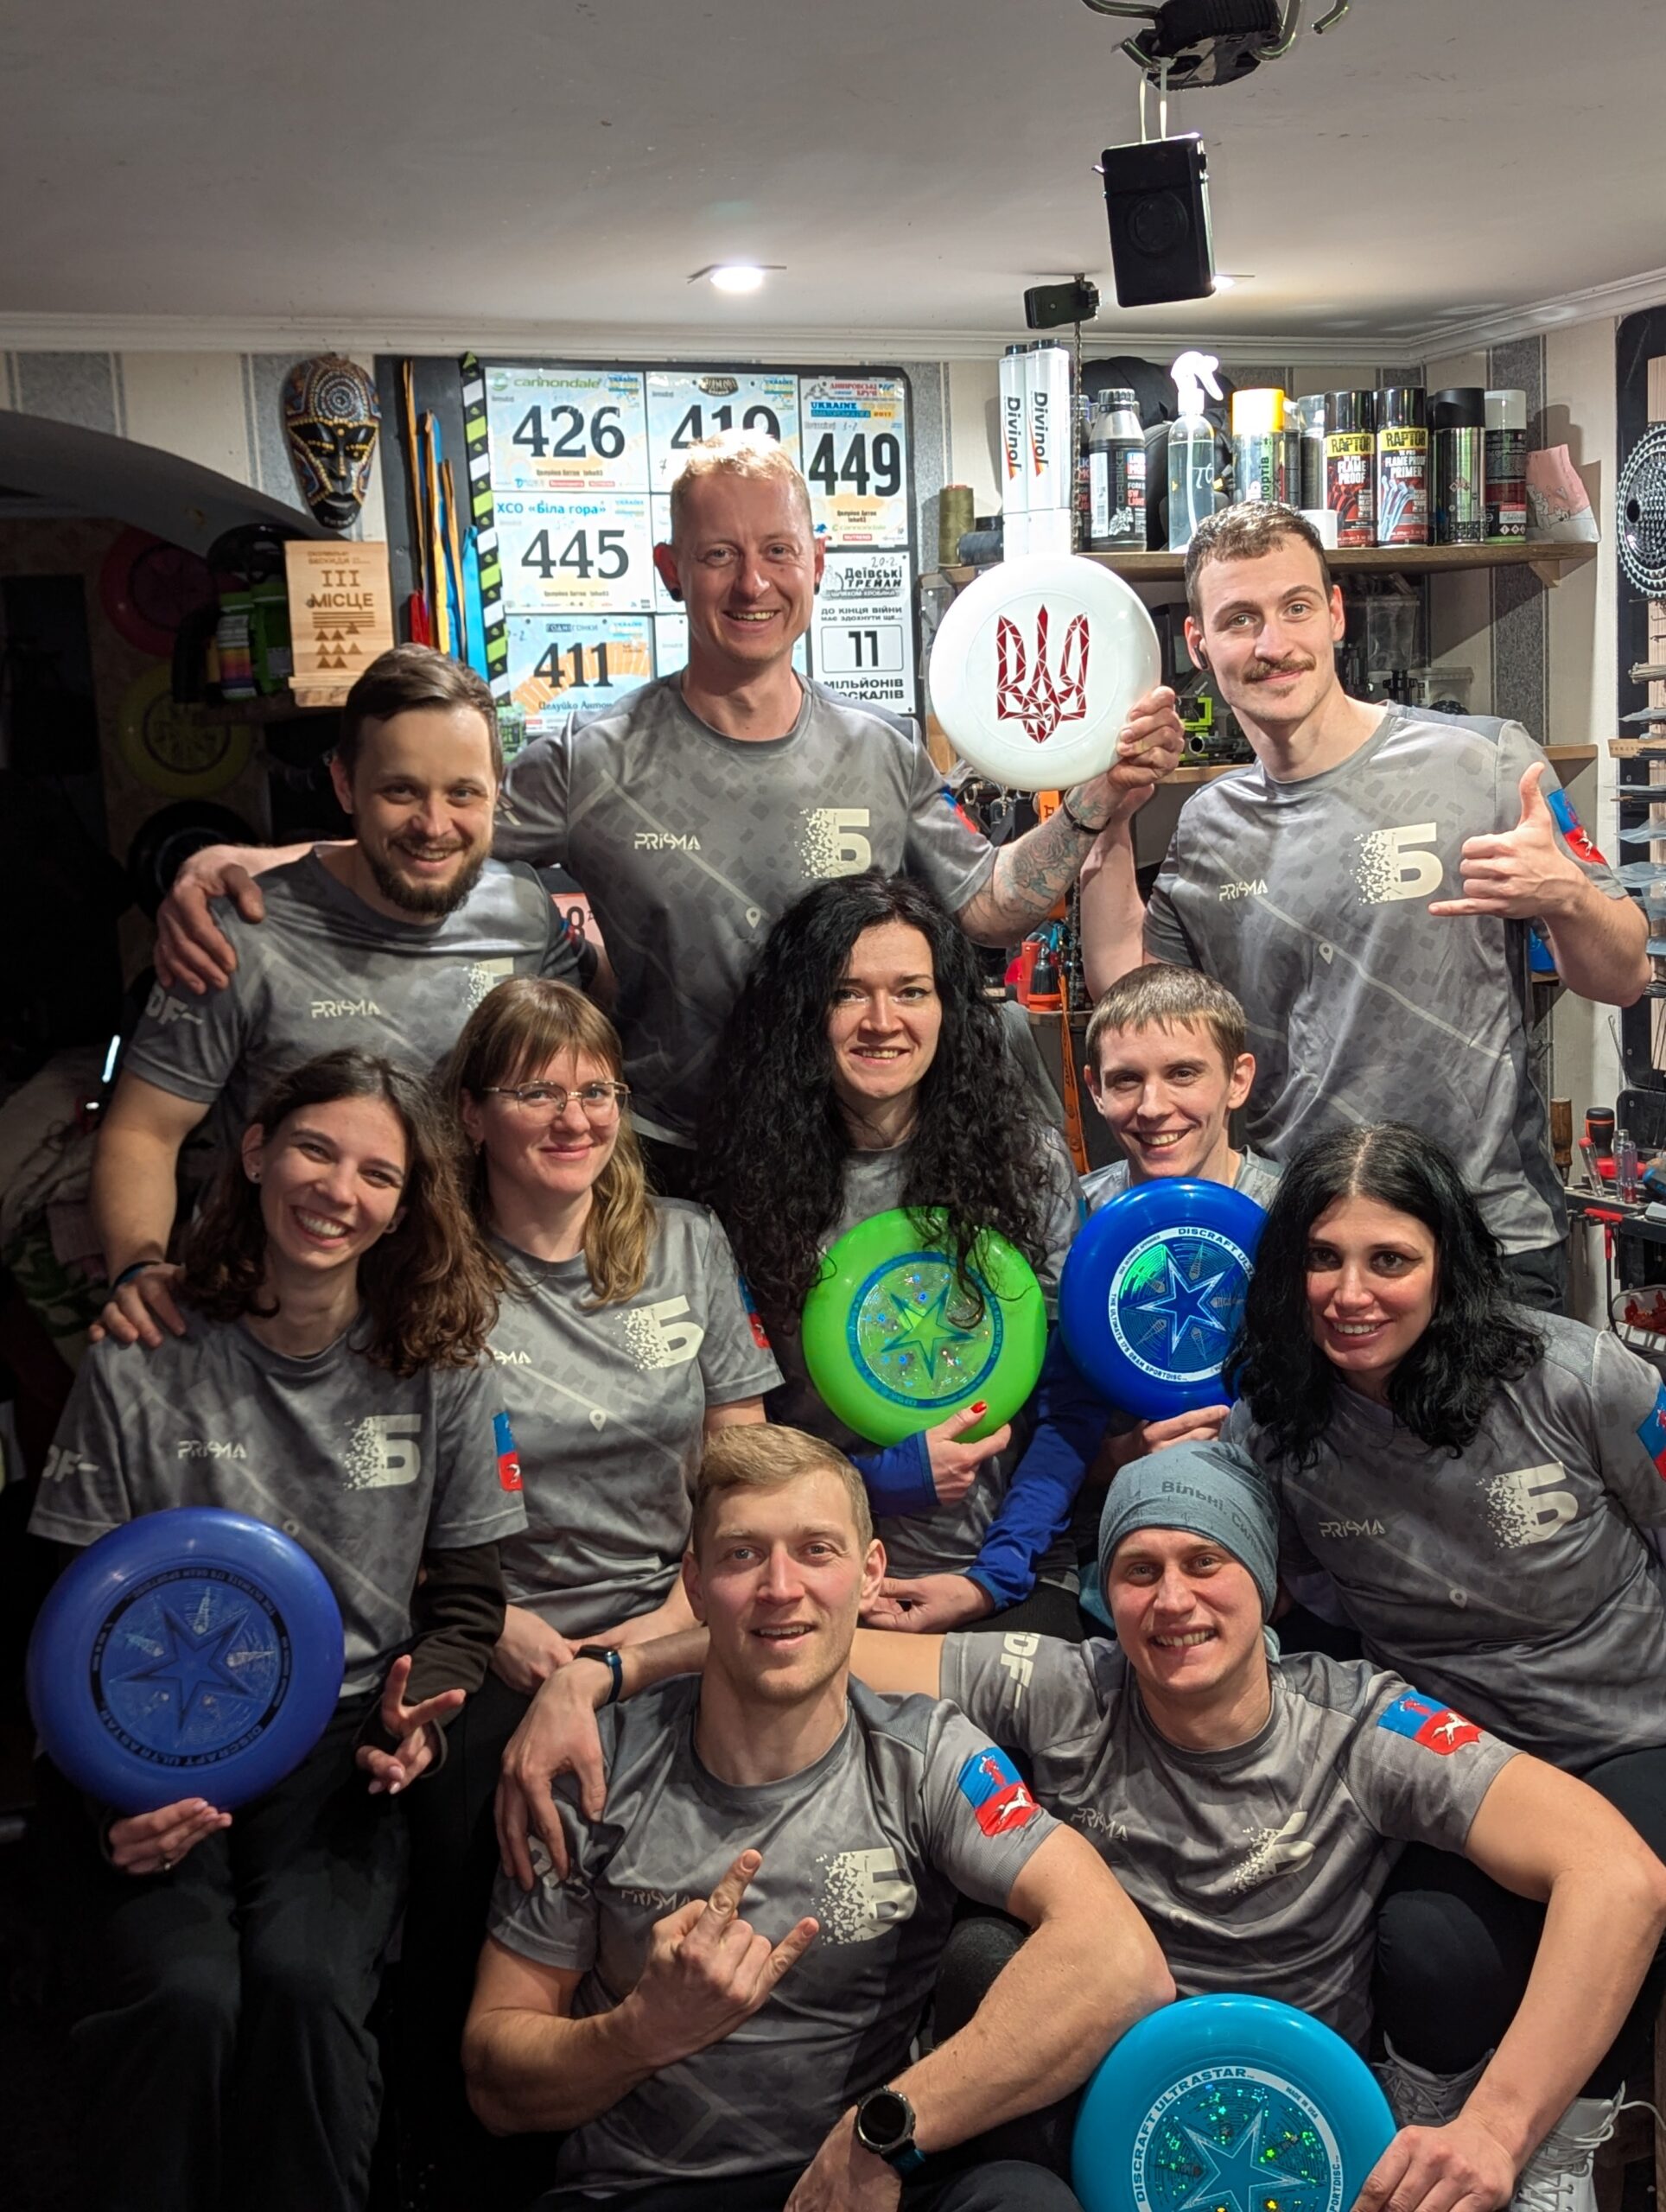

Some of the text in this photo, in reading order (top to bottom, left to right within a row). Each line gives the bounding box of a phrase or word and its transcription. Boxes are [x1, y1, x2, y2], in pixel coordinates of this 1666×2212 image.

[513, 377, 601, 389] cannondale
[811, 401, 857, 410] UKRAINE
[512, 404, 626, 459] 426
[1008, 397, 1022, 469] Divinol
[1034, 391, 1049, 467] Divinol
[1332, 435, 1371, 453] RAPTOR
[1386, 430, 1426, 448] RAPTOR
[809, 432, 900, 497] 449
[1338, 461, 1367, 474] FLAME
[1385, 455, 1427, 467] FLAME PROOF
[1339, 472, 1366, 485] PROOF
[1390, 466, 1422, 479] PRIMER
[569, 505, 607, 517] гора»
[521, 529, 630, 579] 445
[844, 565, 903, 580] Деївські
[311, 593, 374, 610] МІСЦЕ
[821, 605, 902, 616] ДО КІНЦЯ ВІЙНИ
[849, 630, 879, 668] 11
[533, 642, 614, 688] 411
[823, 677, 904, 690] МІЛЬЙОНІВ
[1178, 1227, 1239, 1253] DISCRAFT
[1110, 1308, 1123, 1339] ULTIMATE
[1129, 1351, 1145, 1368] GRAM
[99, 1708, 263, 1766] DISCRAFT ULTRASTAR
[1285, 2086, 1303, 2101] MADE
[1307, 2105, 1319, 2120] USA
[1132, 2068, 1247, 2203] DISCRAFT ULTRASTAR
